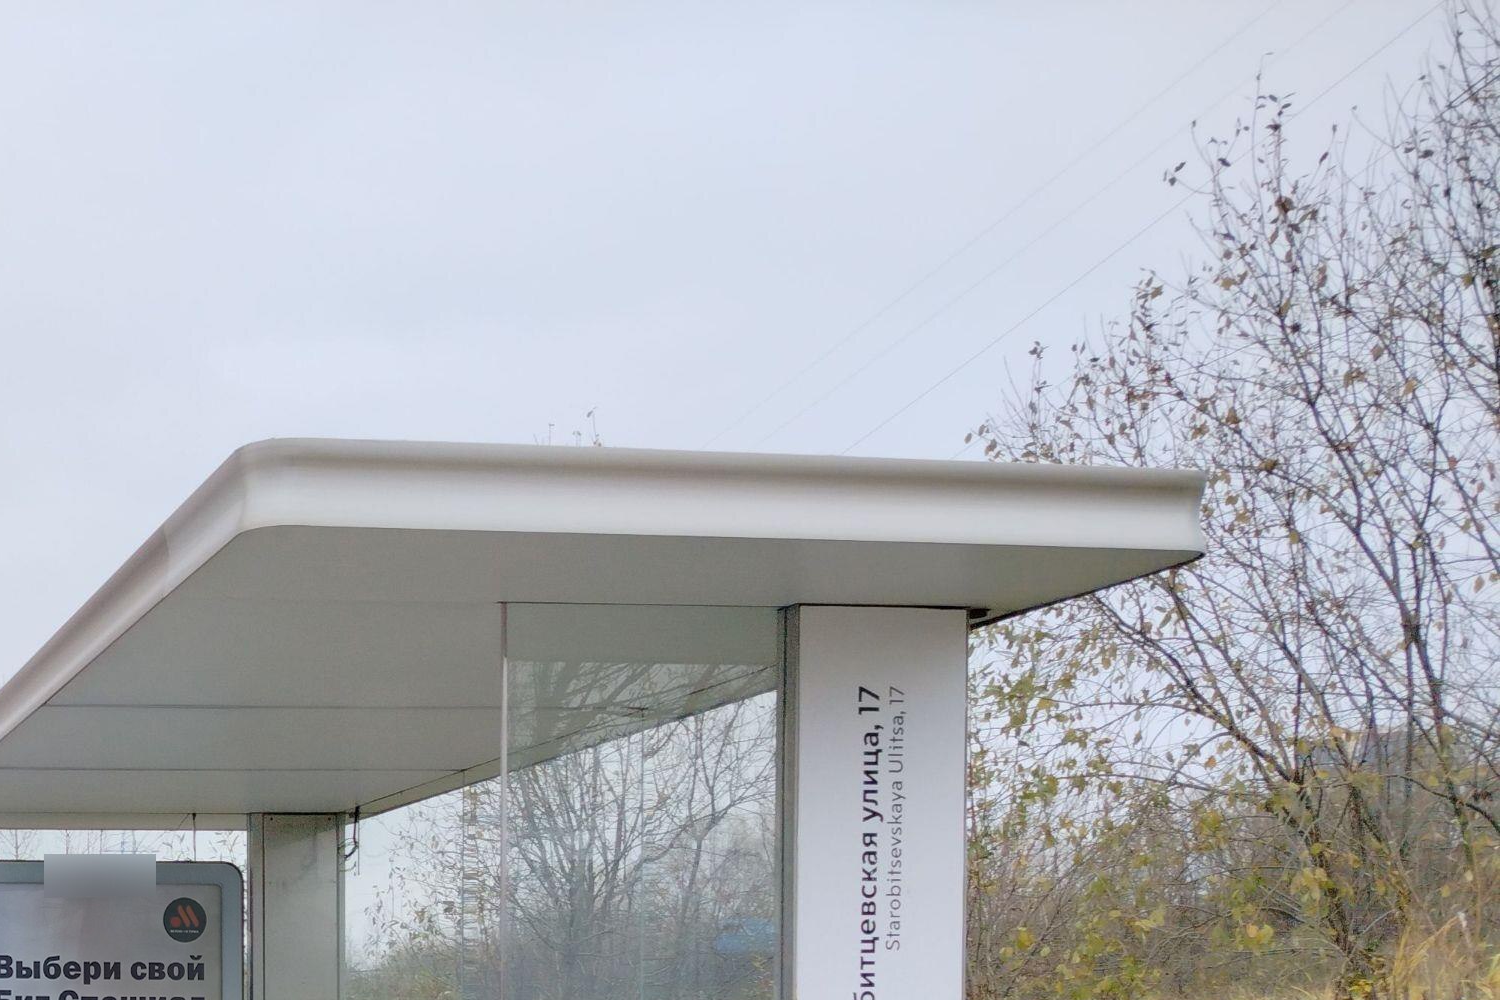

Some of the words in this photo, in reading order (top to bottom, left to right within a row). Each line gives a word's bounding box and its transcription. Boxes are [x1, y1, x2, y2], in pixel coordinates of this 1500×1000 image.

[858, 686, 880, 714] 17
[889, 686, 905, 705] 17
[887, 711, 907, 773] Ulitsa,
[862, 724, 884, 823] улица,
[885, 778, 907, 951] Starobitsevskaya
[130, 955, 205, 981] свой
